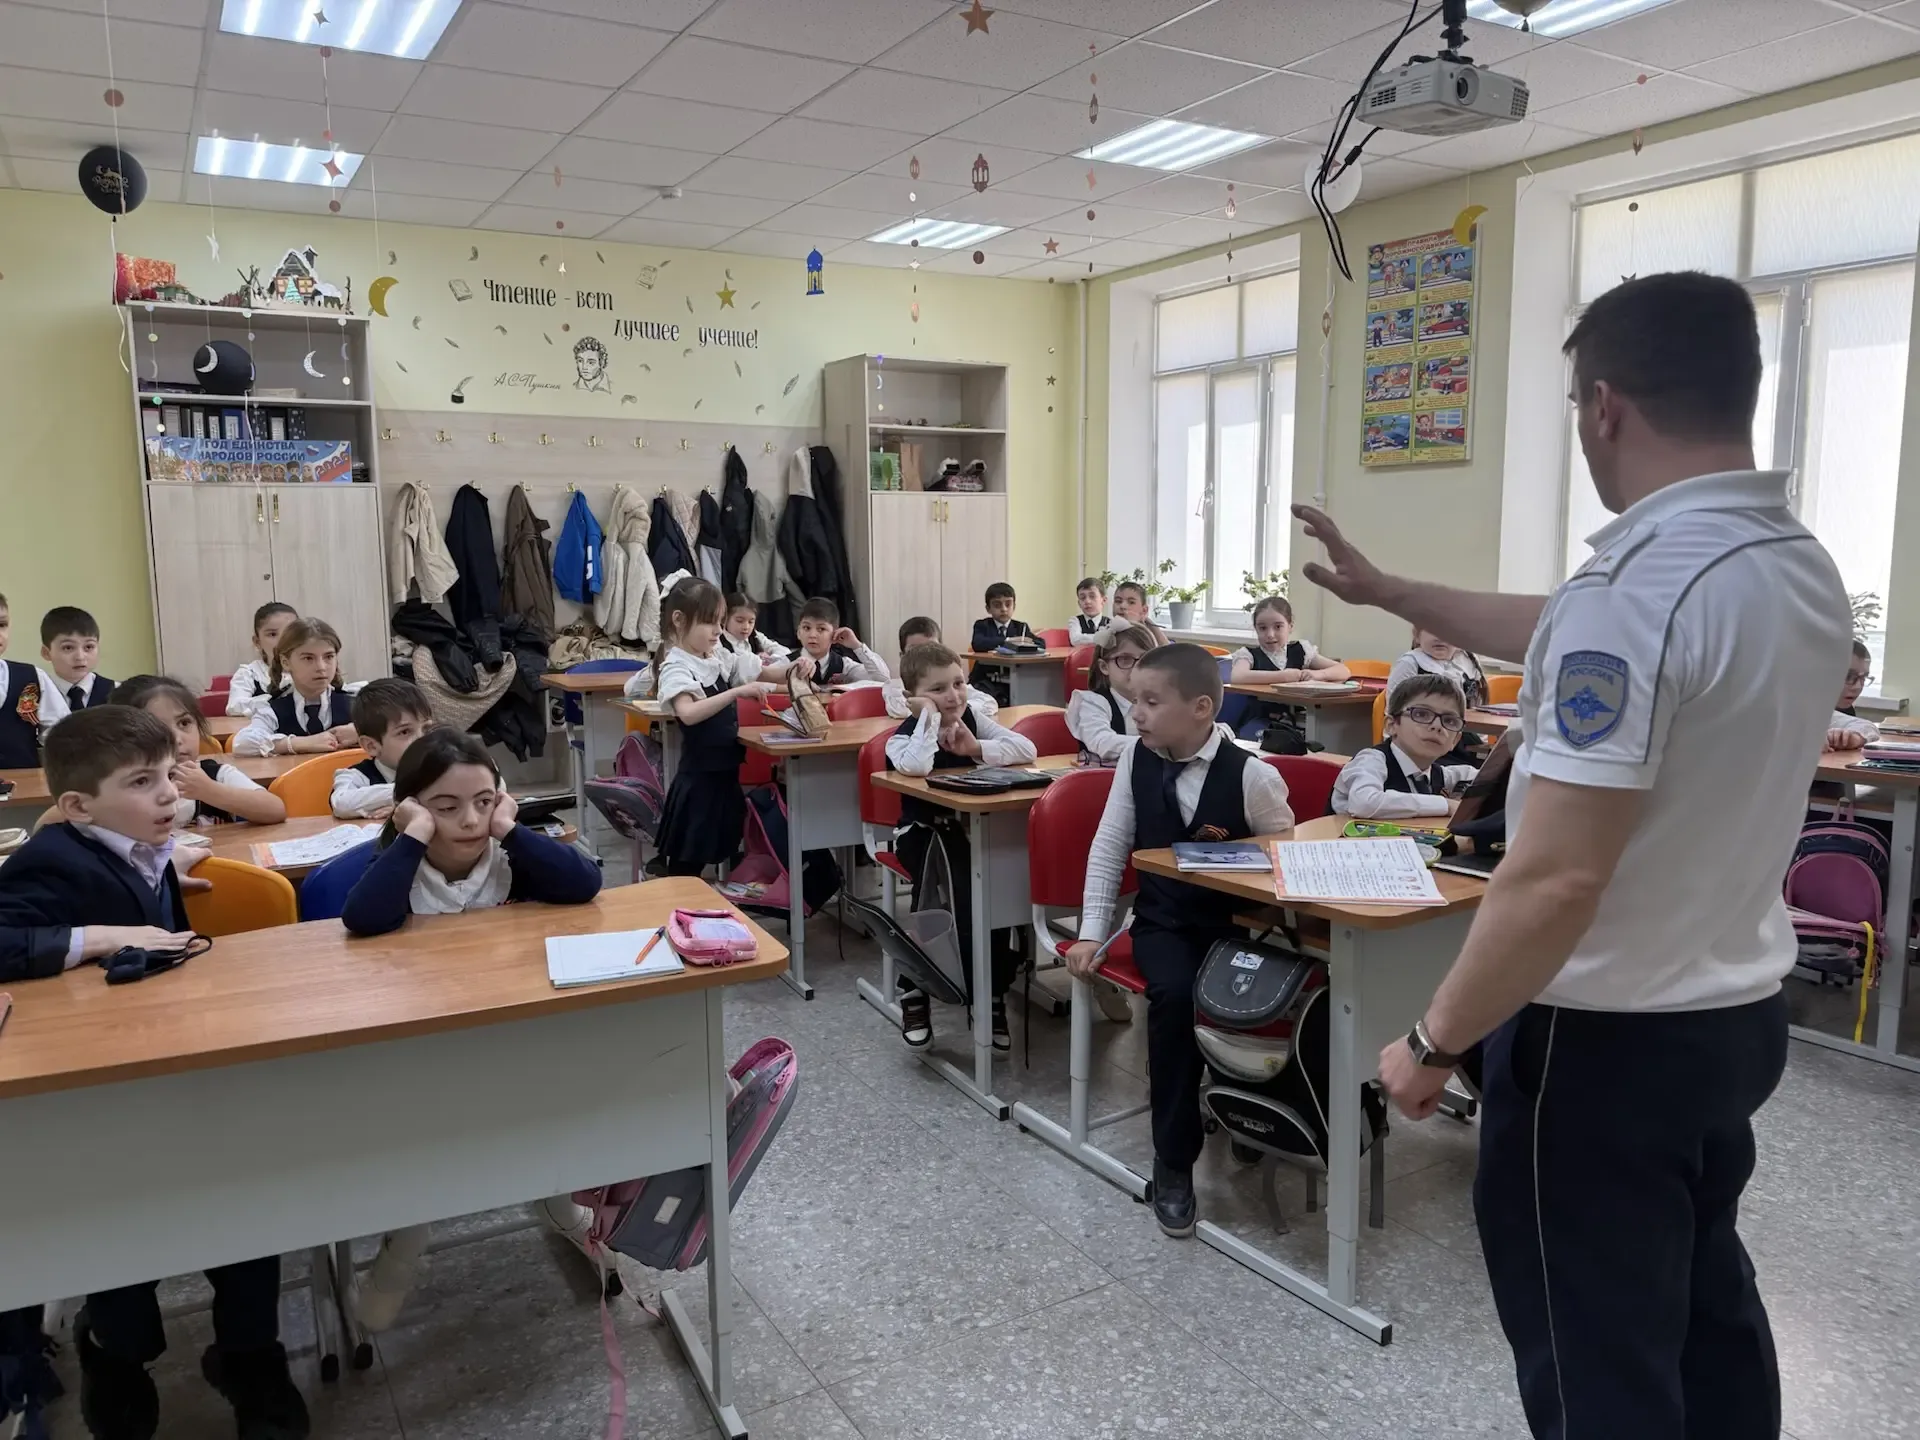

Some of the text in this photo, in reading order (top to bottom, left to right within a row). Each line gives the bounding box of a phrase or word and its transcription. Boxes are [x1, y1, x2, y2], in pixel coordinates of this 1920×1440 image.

[1426, 237, 1461, 251] ДВИЖЕНИ
[483, 278, 557, 307] Чтение
[576, 290, 614, 311] вот
[613, 318, 758, 349] лучшее учение!
[204, 440, 296, 451] ГОД ЕДИНСТВА
[256, 451, 305, 461] РОССИИ
